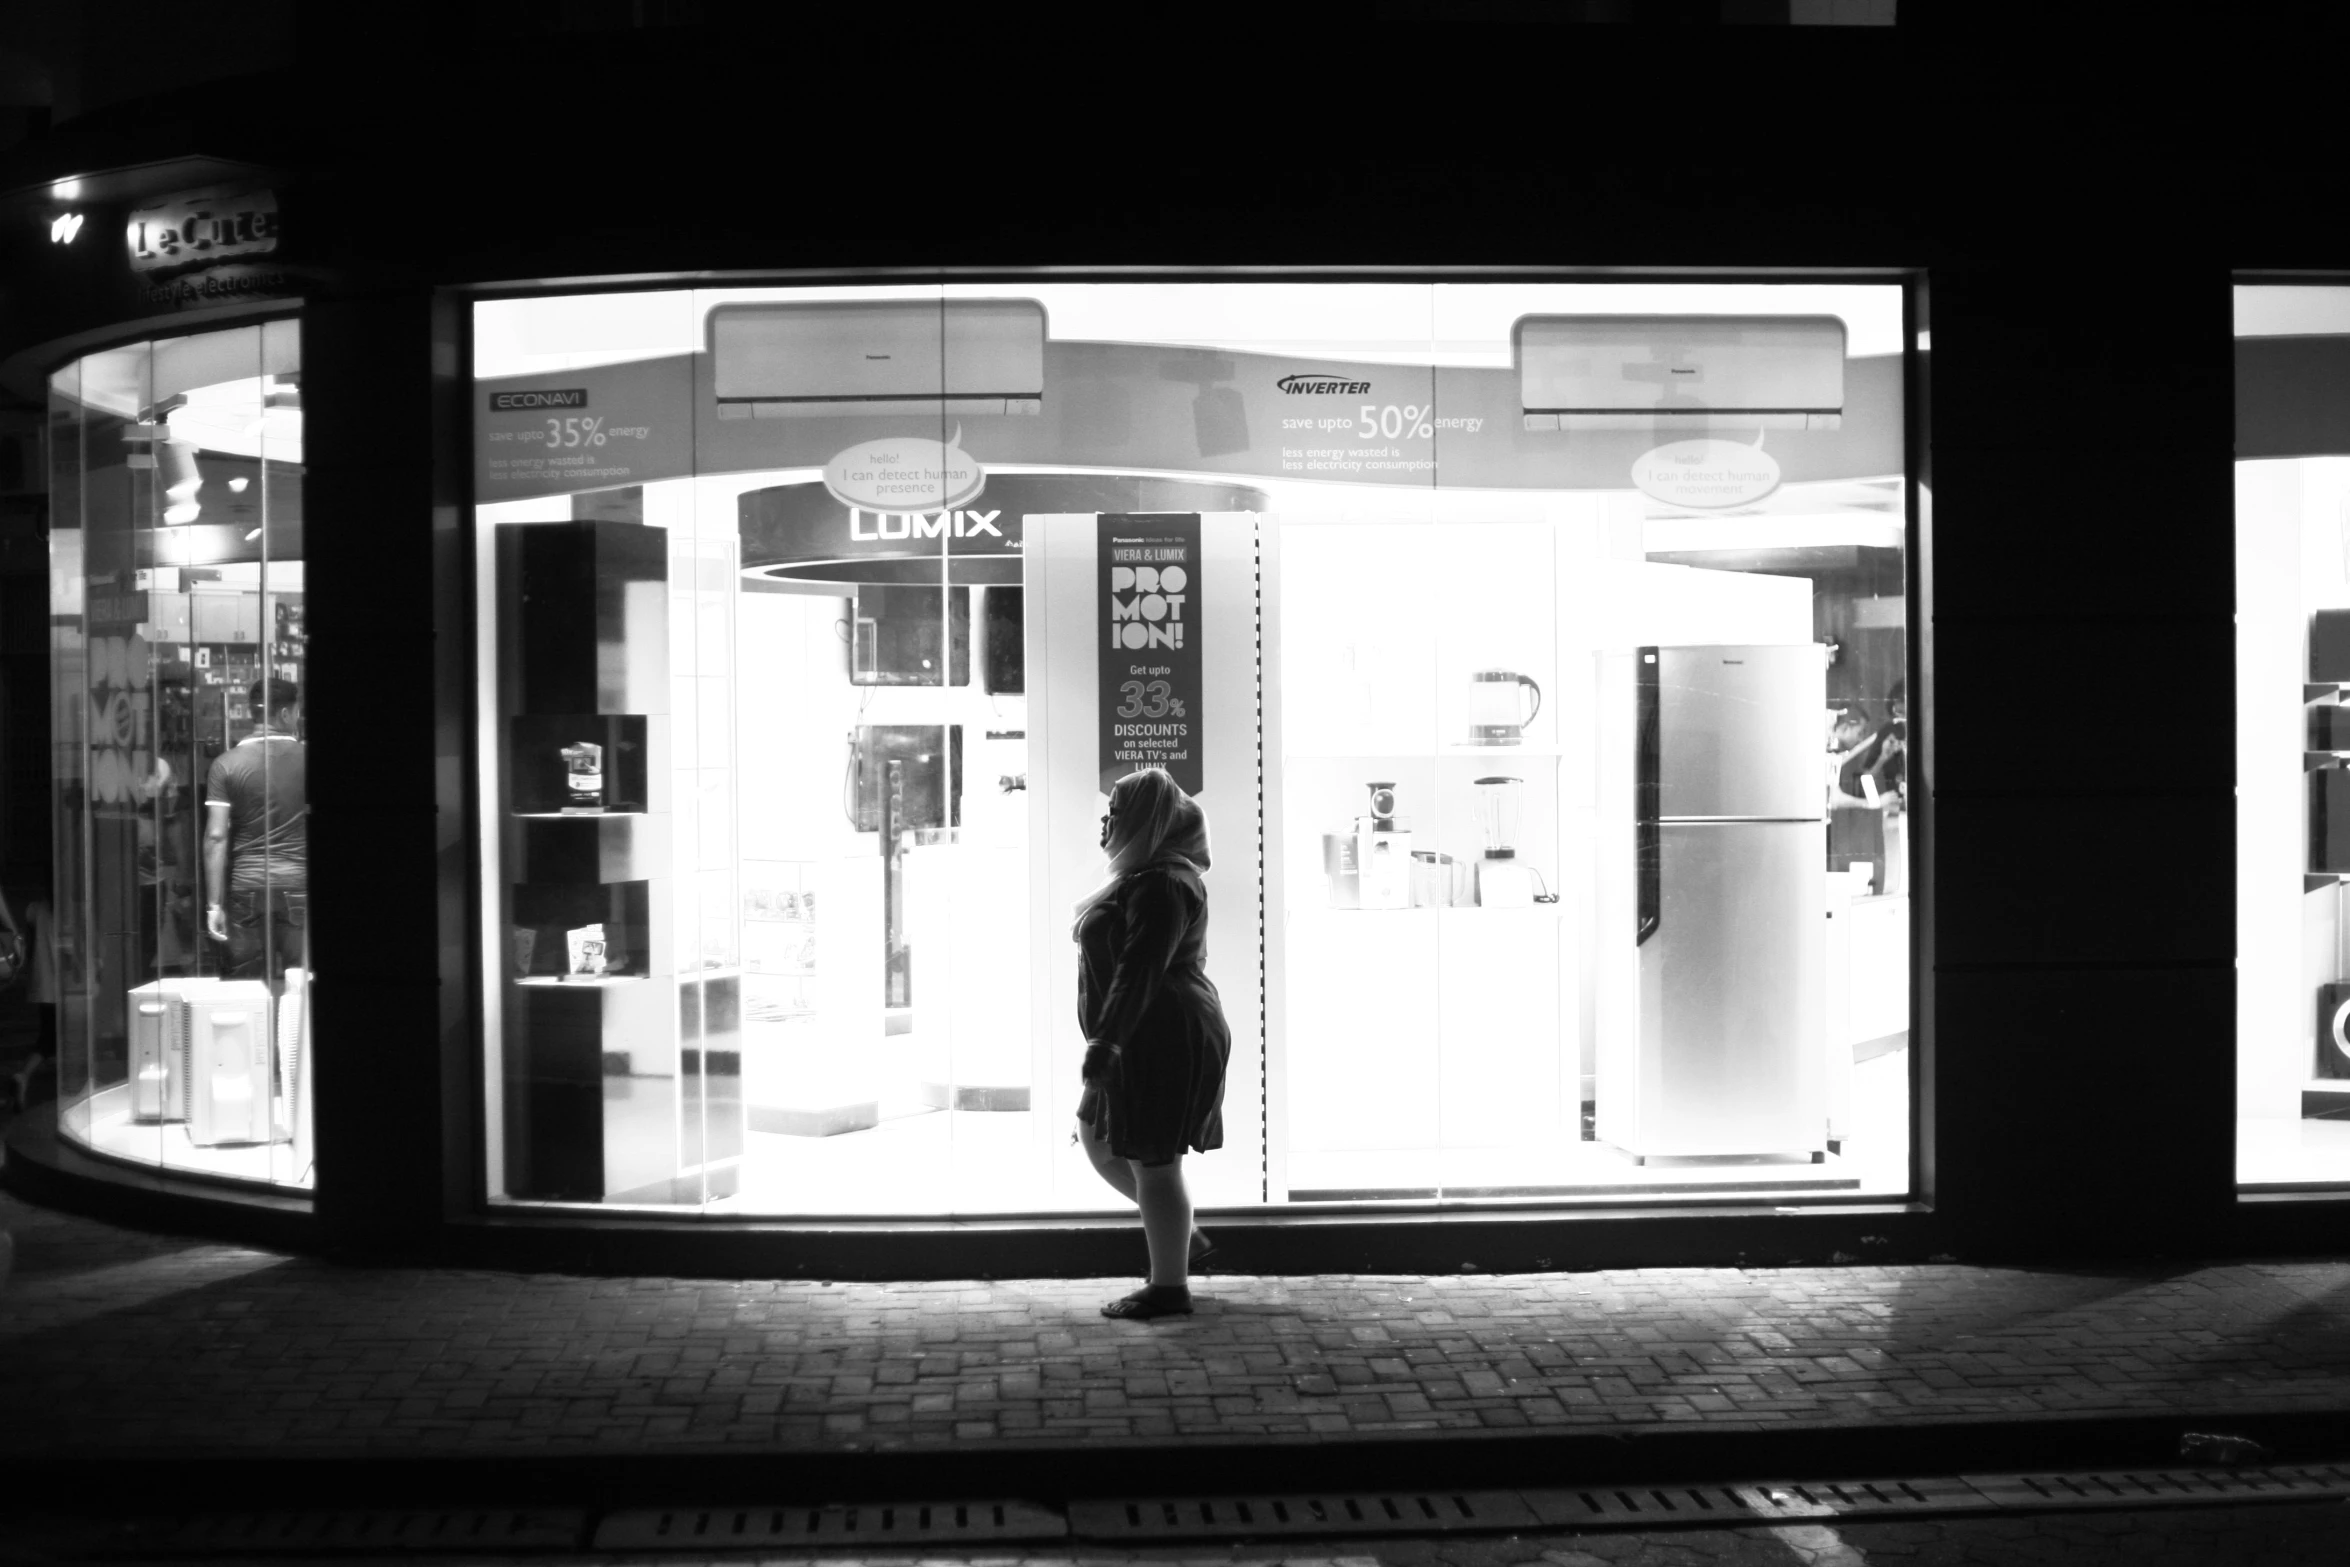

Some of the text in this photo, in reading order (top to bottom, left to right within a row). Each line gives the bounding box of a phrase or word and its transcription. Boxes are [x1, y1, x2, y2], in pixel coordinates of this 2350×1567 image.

[196, 274, 285, 296] electronics
[1282, 380, 1371, 394] INVERTER
[497, 392, 579, 408] ECONAVI
[1282, 405, 1483, 439] save upto 50% energy
[489, 416, 649, 448] save upto 35% energy
[870, 454, 900, 464] hello!
[1282, 447, 1400, 460] less energy wasted is
[489, 455, 595, 469] less energy wasted is
[1282, 459, 1438, 472] less electricity consumption
[489, 465, 630, 480] less electricity consumption
[843, 469, 968, 481] I can detect human
[1648, 469, 1770, 482] I can detect human
[876, 484, 935, 496] presence
[1676, 484, 1743, 495] movement
[851, 507, 1003, 541] LUMIX
[1114, 549, 1184, 561] VIERA & LUMIX
[1112, 566, 1187, 593] PRO
[1112, 594, 1185, 621] MOT
[1112, 621, 1184, 651] ION!
[1130, 665, 1171, 677] Get upto
[1117, 680, 1186, 718] 33%
[1114, 723, 1187, 736] DISCOUNTS
[1123, 738, 1178, 748] on selected
[1115, 749, 1187, 760] VIERA TV's and
